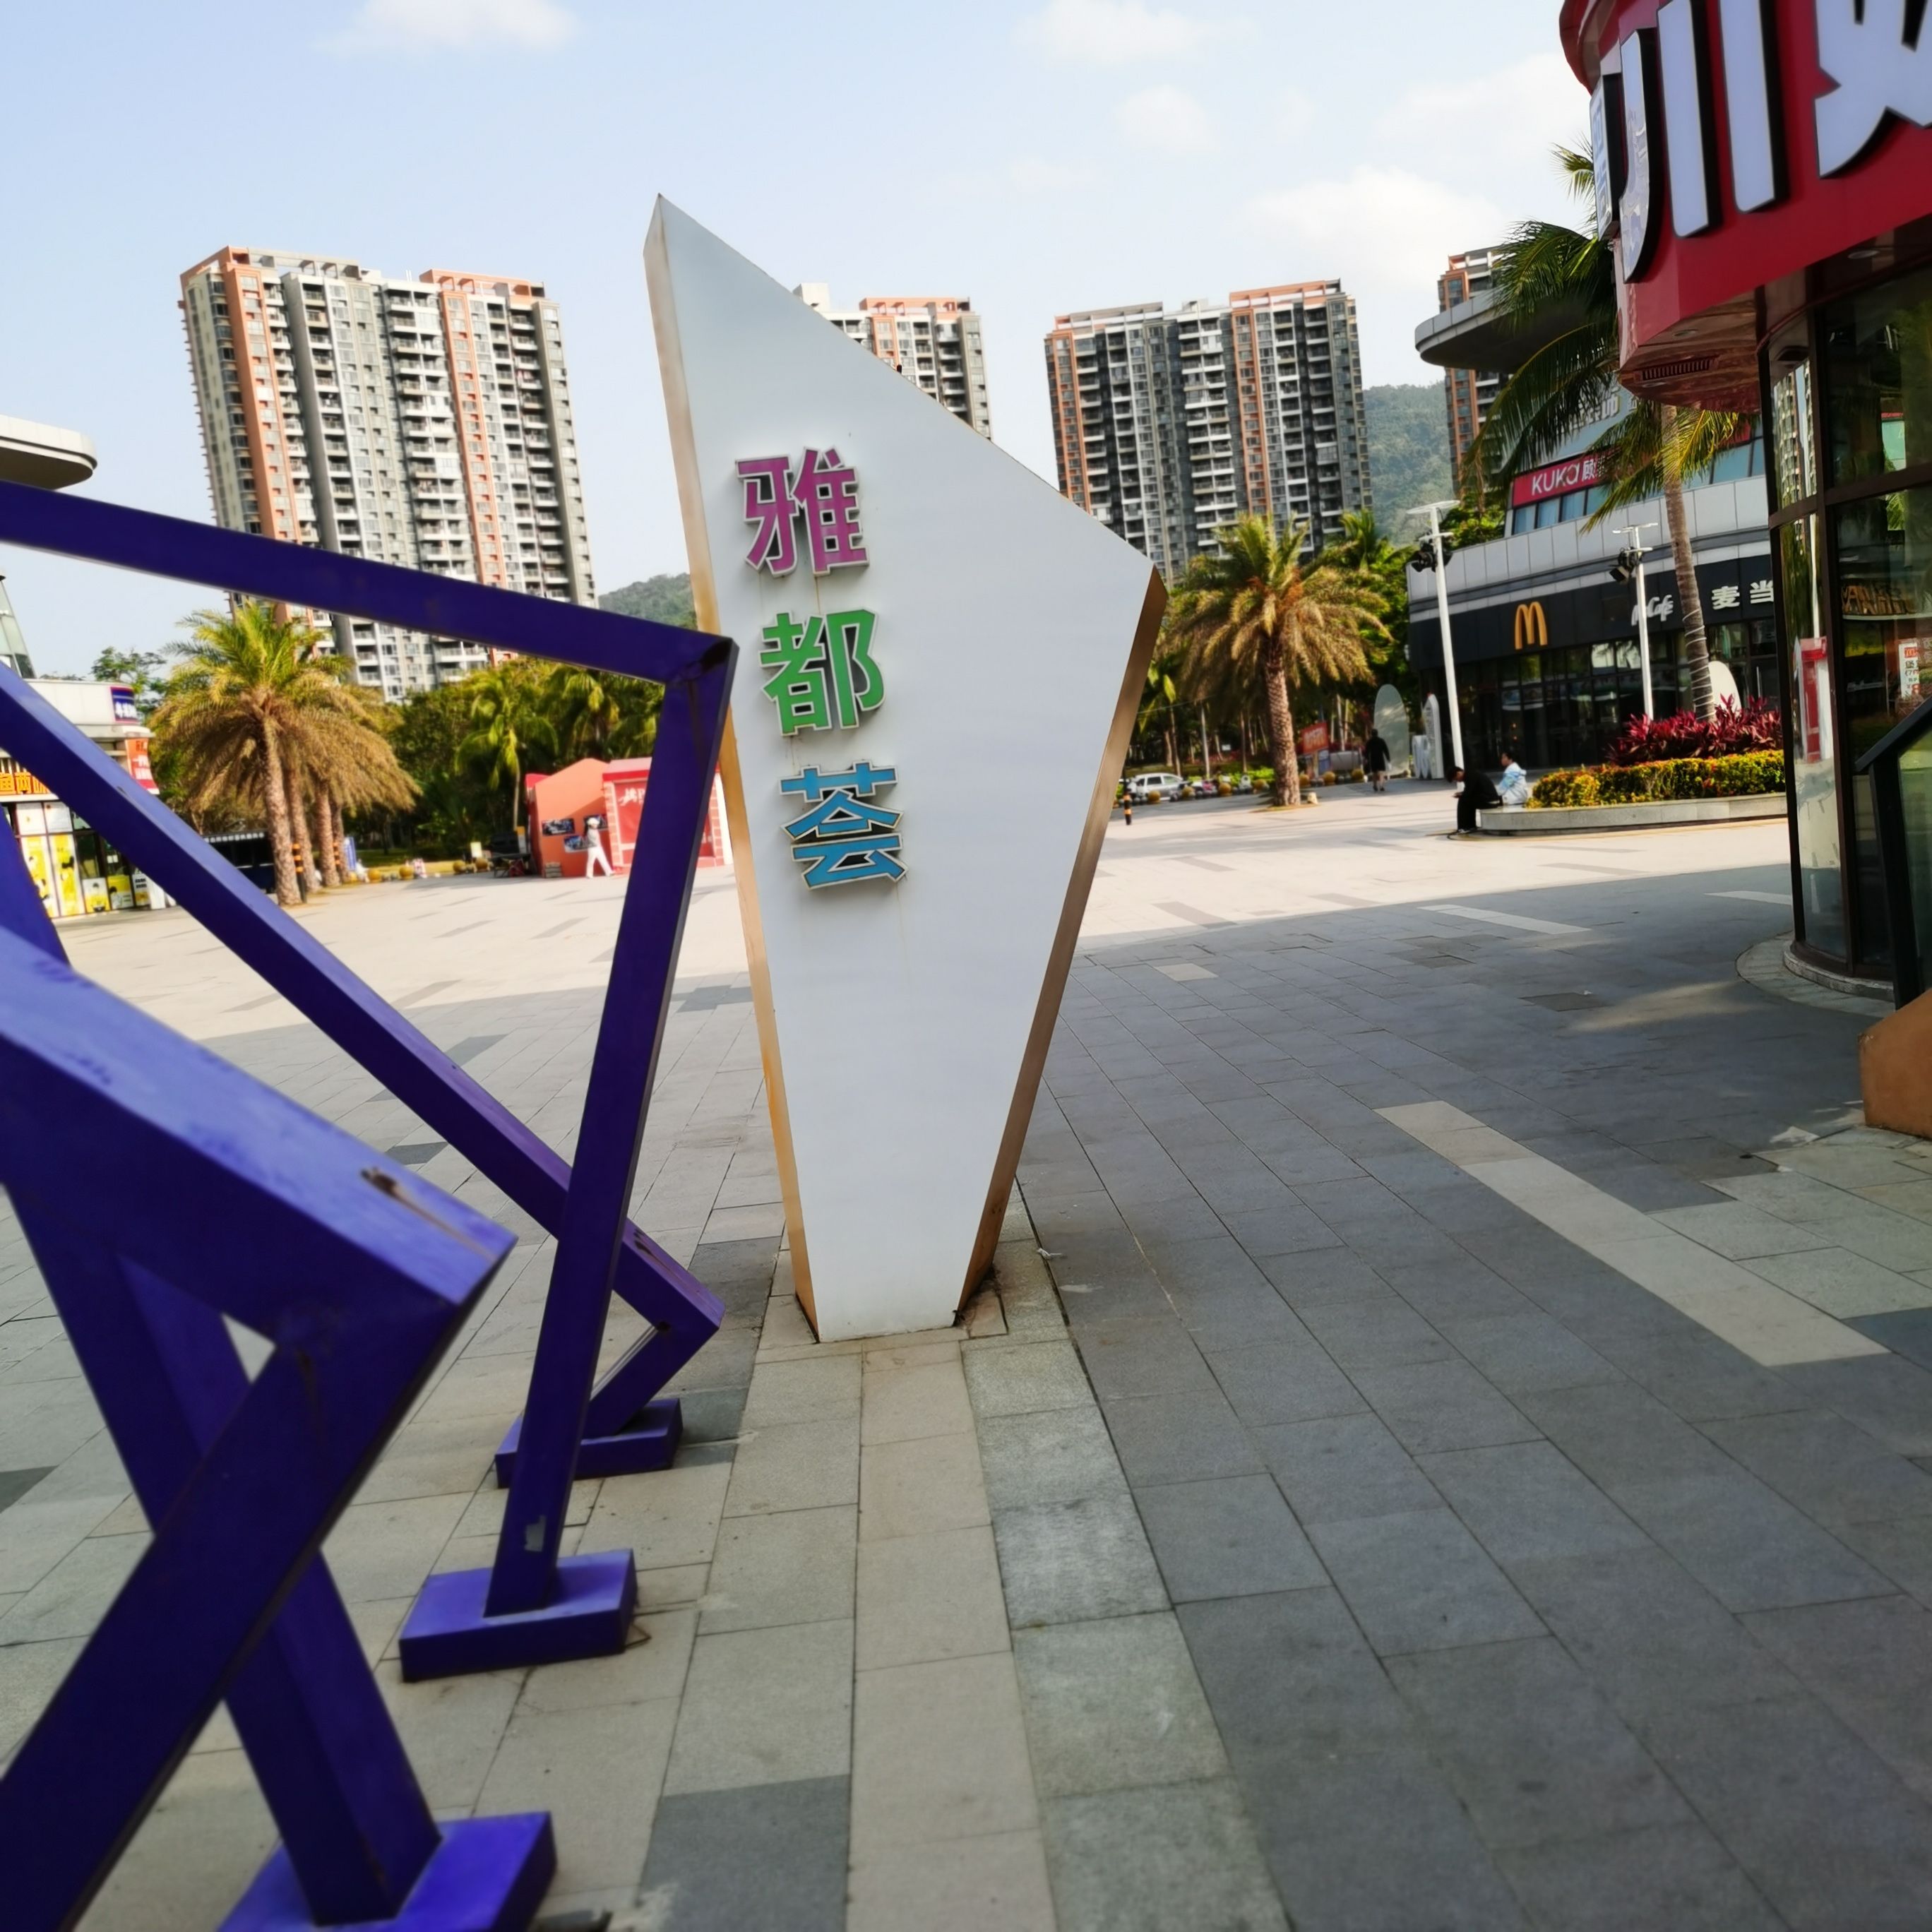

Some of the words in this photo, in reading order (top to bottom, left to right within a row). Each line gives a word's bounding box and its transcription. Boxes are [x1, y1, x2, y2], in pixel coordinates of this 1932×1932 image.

[735, 446, 909, 890] 雅都荟
[1711, 578, 1775, 611] 麦当
